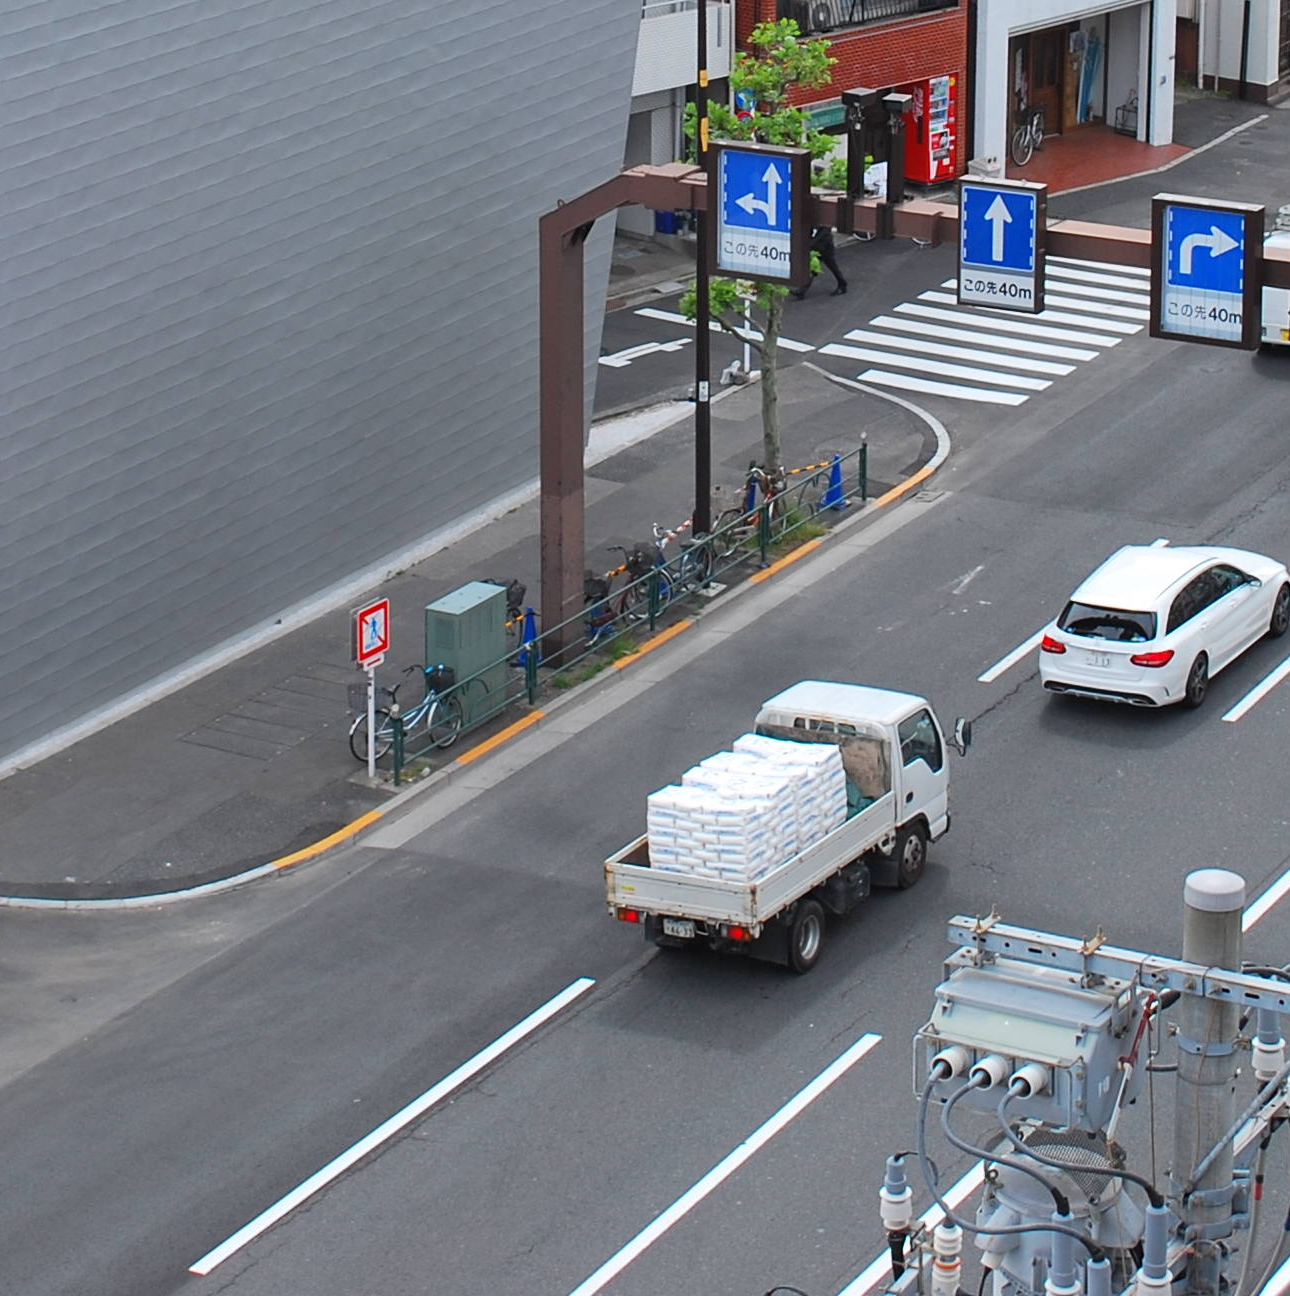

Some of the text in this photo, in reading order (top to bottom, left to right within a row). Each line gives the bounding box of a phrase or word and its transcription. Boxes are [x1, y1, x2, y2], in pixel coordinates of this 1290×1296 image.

[723, 240, 791, 263] この先40m
[963, 278, 1033, 300] この先40m
[1167, 301, 1243, 325] この先40m
